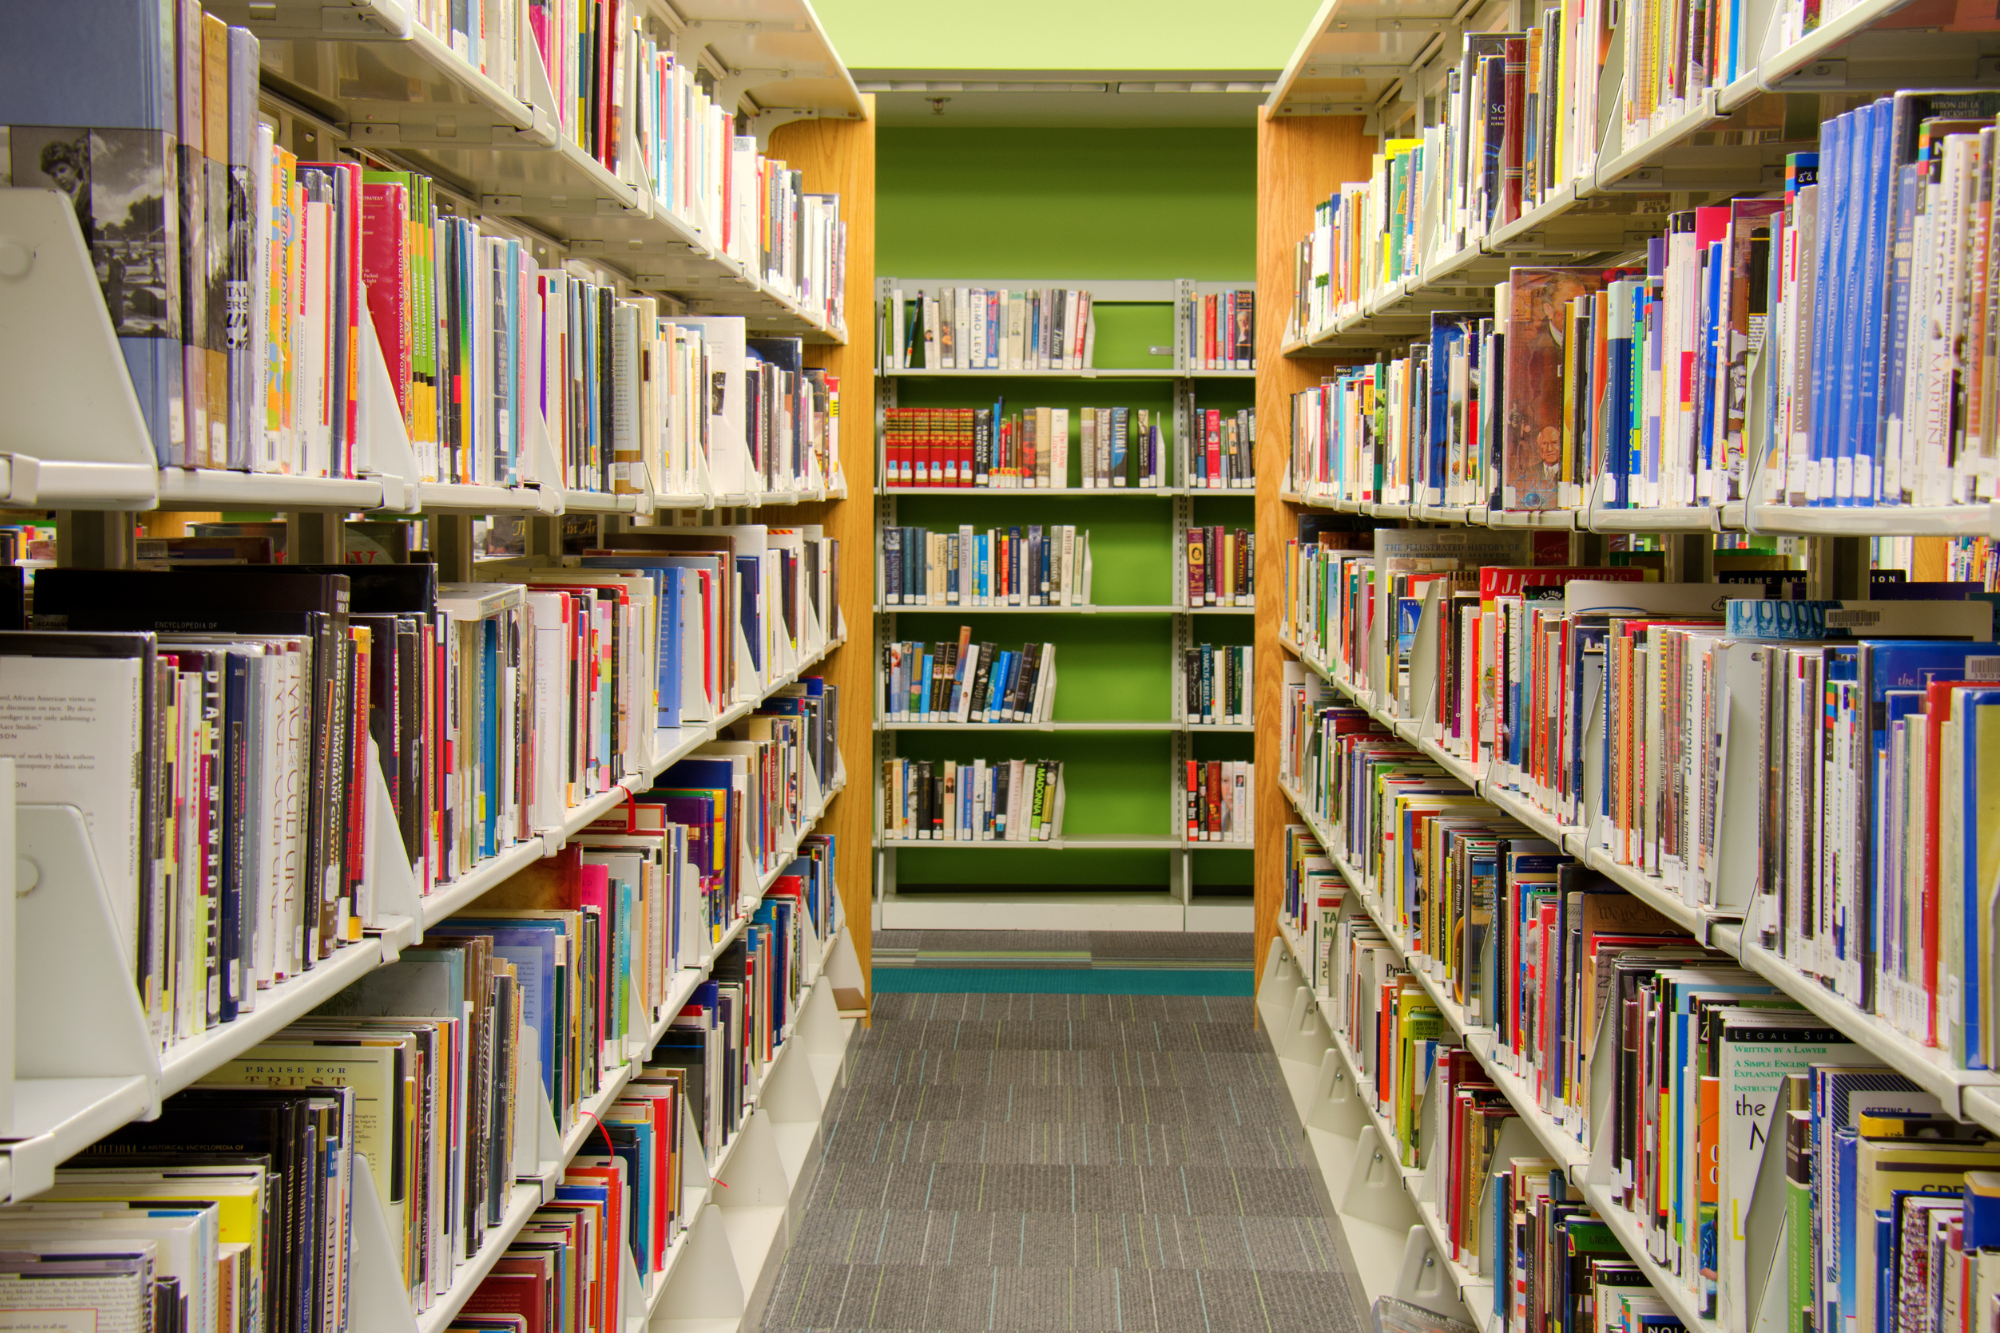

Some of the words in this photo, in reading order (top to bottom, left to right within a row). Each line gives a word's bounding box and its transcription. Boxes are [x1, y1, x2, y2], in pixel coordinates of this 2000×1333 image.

[1952, 168, 1960, 224] LAZARUS
[1973, 217, 1987, 261] MEN
[1801, 249, 1810, 315] WOMEN'S
[1948, 259, 1956, 283] THE
[1972, 266, 1985, 293] IN
[1799, 320, 1807, 370] RIGHTS
[1943, 287, 1954, 359] HURRICANE
[1927, 354, 1942, 445] MARTIN
[1384, 543, 1404, 552] THE
[1407, 543, 1464, 552] ILLUSTRATED
[1467, 543, 1506, 552] HISTORY
[1509, 608, 1520, 675] KRUGMAN
[1898, 673, 1914, 686] the
[205, 671, 220, 758] DIANE
[132, 740, 136, 752] on
[331, 725, 340, 803] IMMIGRANT
[1033, 768, 1046, 814] MADONNA
[130, 822, 135, 832] to
[130, 835, 134, 846] Be
[205, 785, 220, 967] McWHORTER
[1735, 1030, 1787, 1039] LEGAL
[1736, 1094, 1766, 1116] the
[303, 1323, 309, 1333] of
